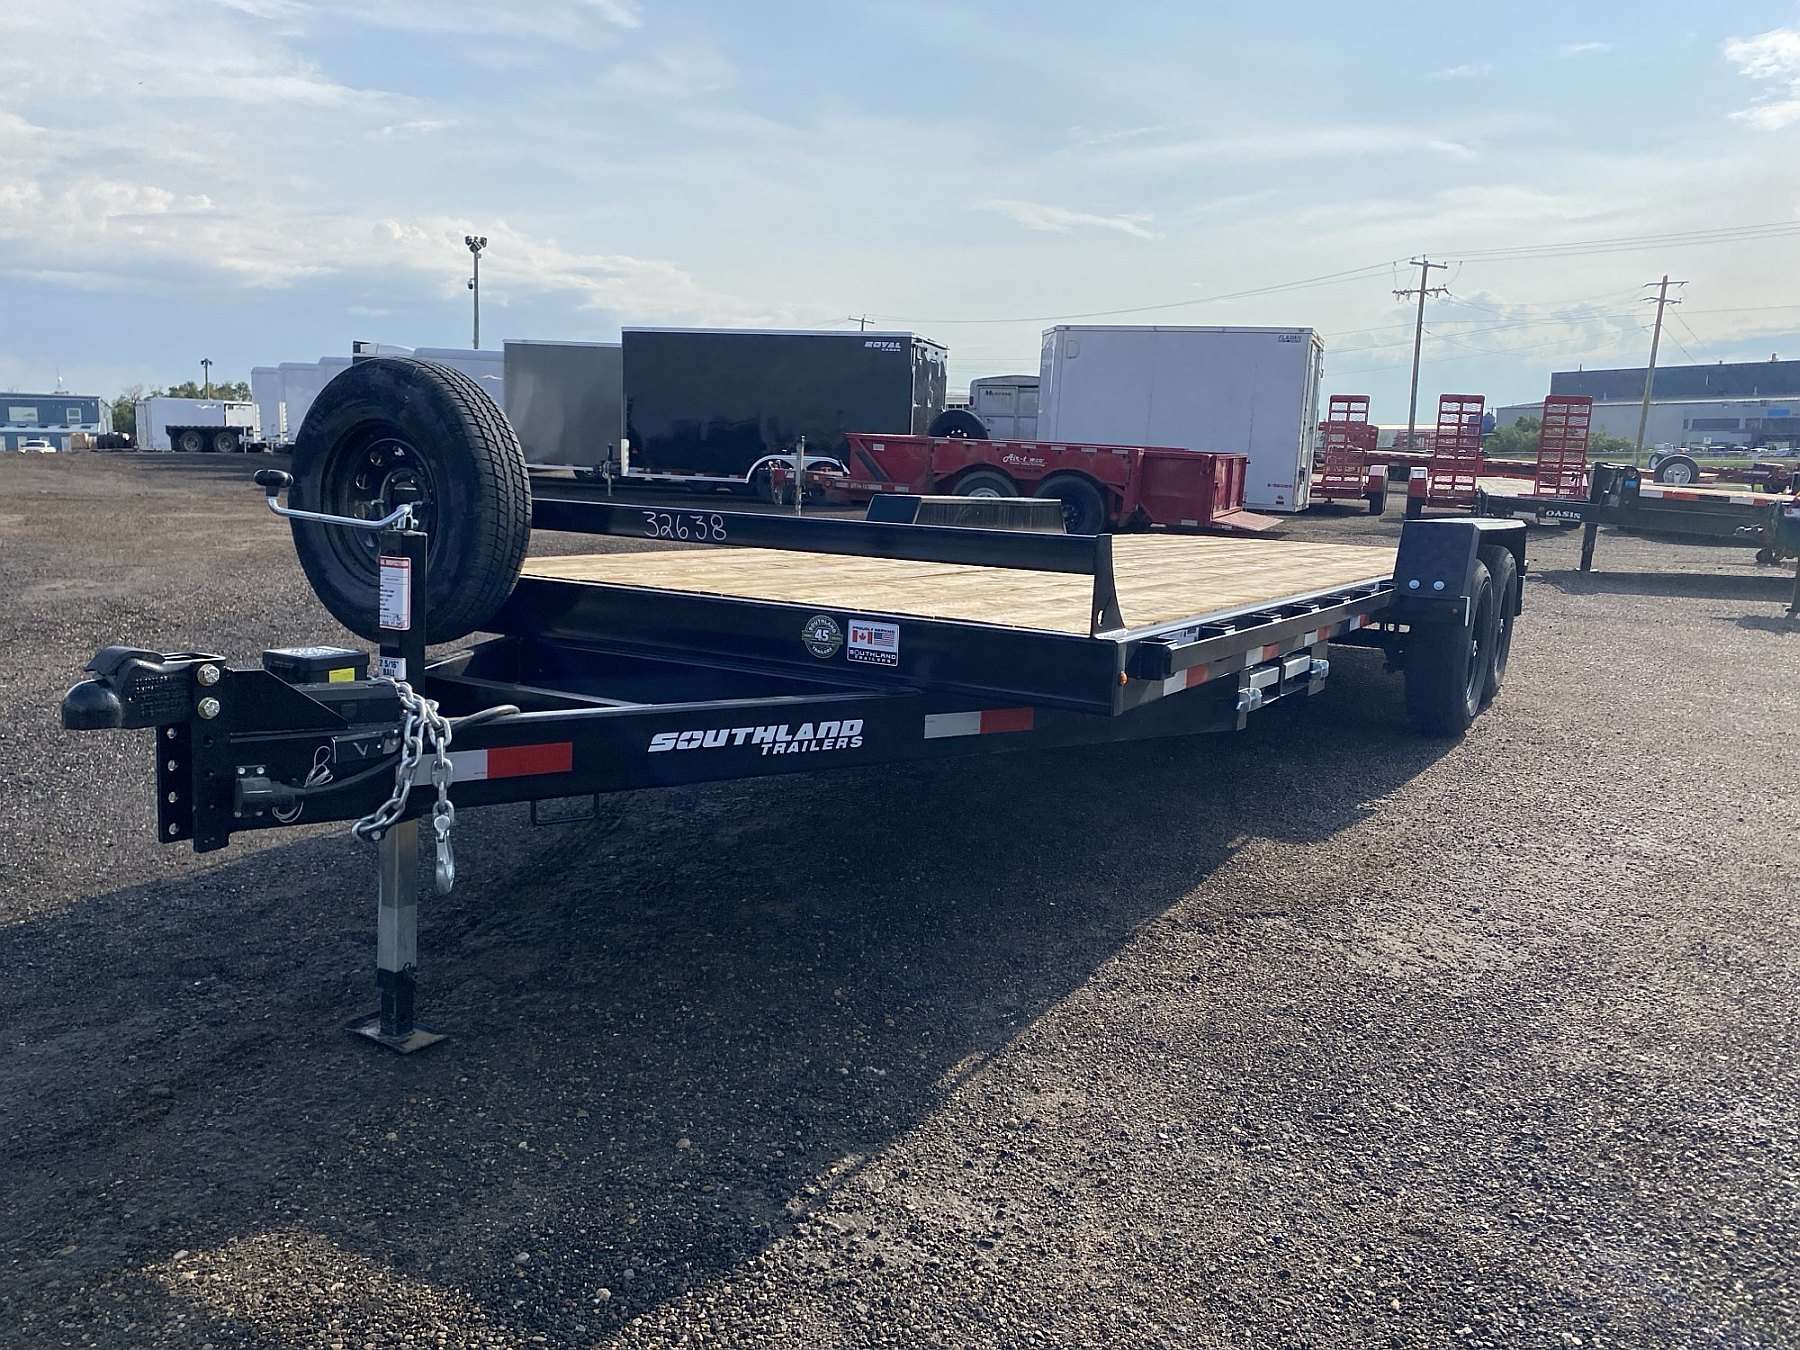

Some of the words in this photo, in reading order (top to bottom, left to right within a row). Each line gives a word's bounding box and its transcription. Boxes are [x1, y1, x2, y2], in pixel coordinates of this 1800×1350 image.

[1545, 510, 1582, 519] OASIS
[642, 511, 727, 541] 32638
[814, 629, 830, 642] 45
[849, 649, 896, 660] SOUTHLAND
[854, 655, 891, 664] TRAILERS
[648, 719, 864, 753] SOUTHLAND
[761, 736, 864, 756] TRAILERS
